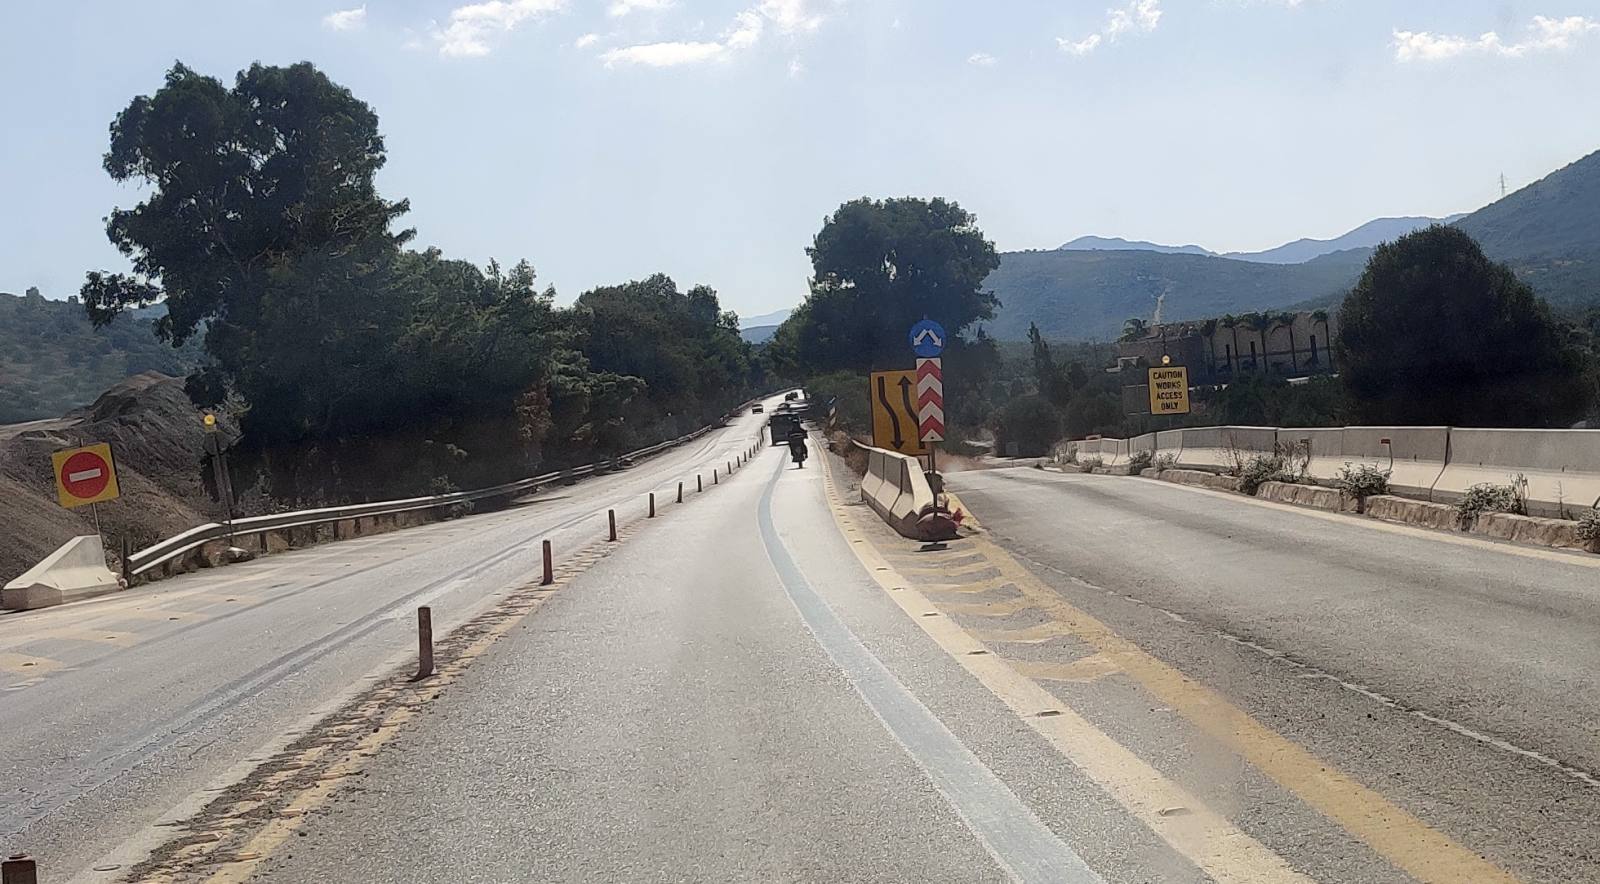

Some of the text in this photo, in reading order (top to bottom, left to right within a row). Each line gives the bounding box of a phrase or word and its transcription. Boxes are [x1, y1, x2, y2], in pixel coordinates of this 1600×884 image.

[1153, 371, 1183, 380] CAUTION
[1156, 381, 1181, 390] WORKS
[1157, 391, 1183, 400] ACCESS
[1161, 402, 1179, 410] ONLY
